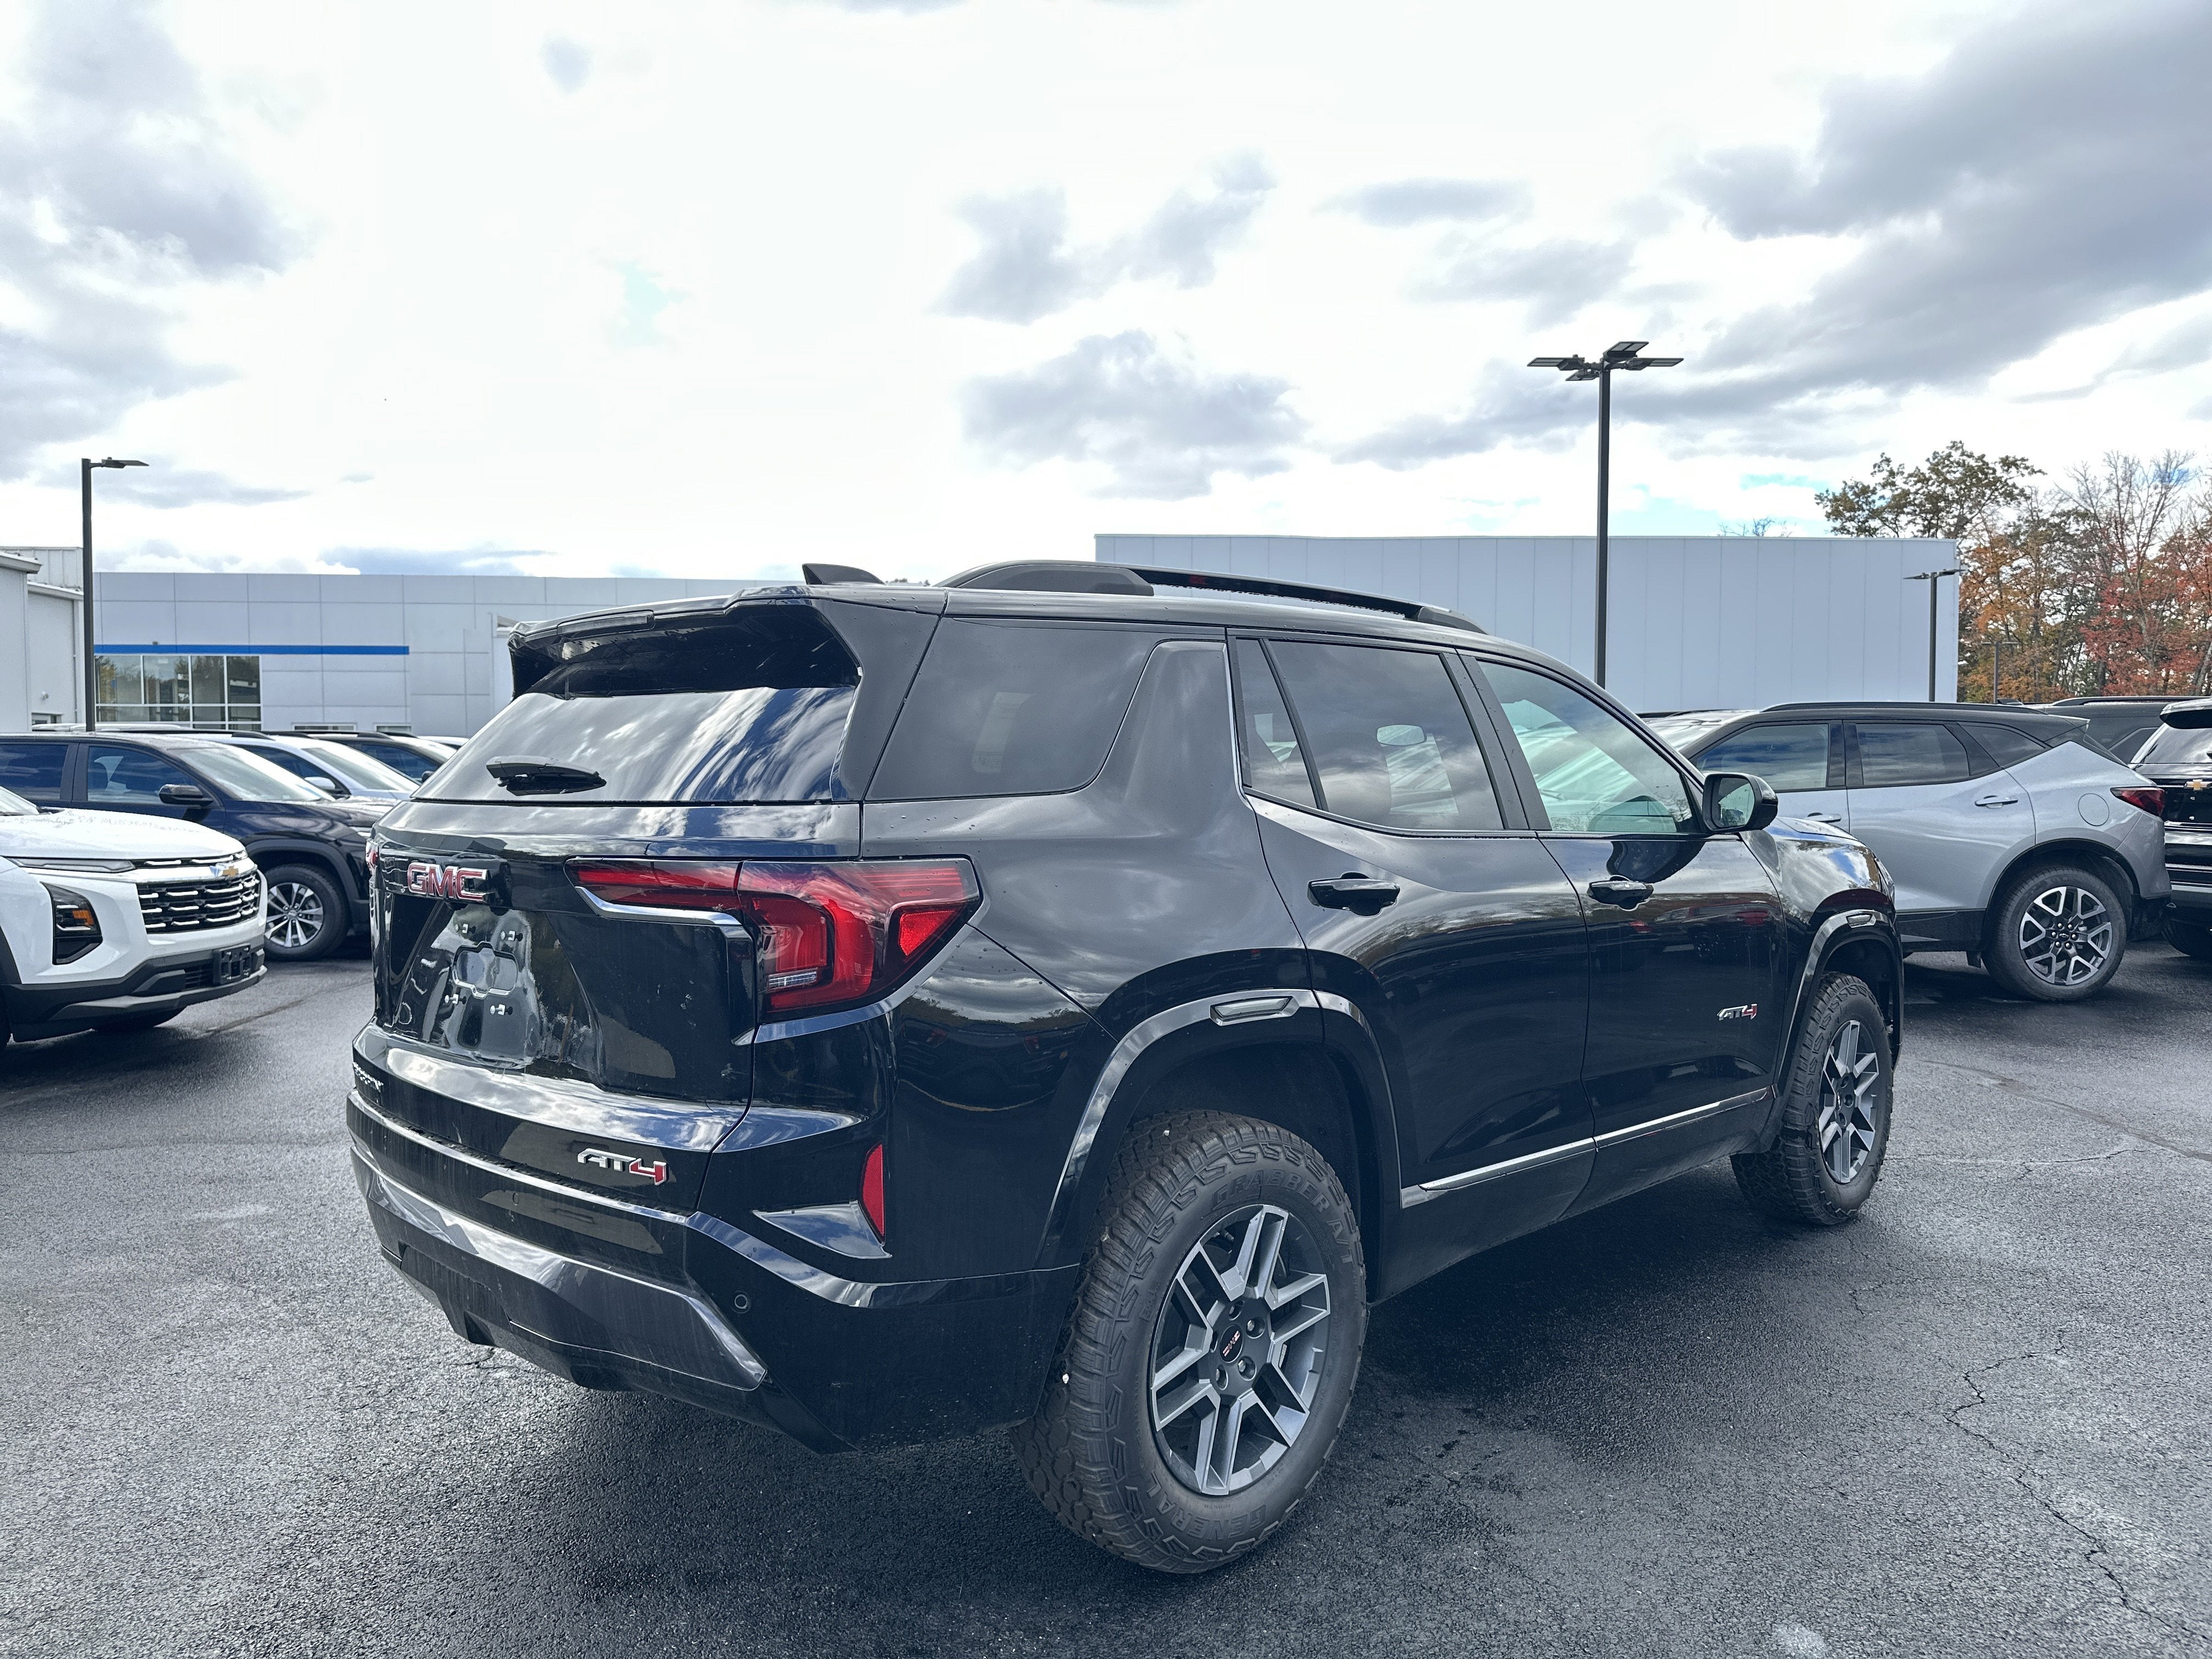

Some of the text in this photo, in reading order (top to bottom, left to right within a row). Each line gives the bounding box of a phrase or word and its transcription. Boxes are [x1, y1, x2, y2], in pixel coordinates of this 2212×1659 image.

[407, 862, 488, 901] GMC
[1717, 1003, 1757, 1021] AT4
[578, 1148, 667, 1186] AT4
[1211, 1169, 1356, 1267] GRABBER A/T
[1146, 1470, 1267, 1541] GENERAL
